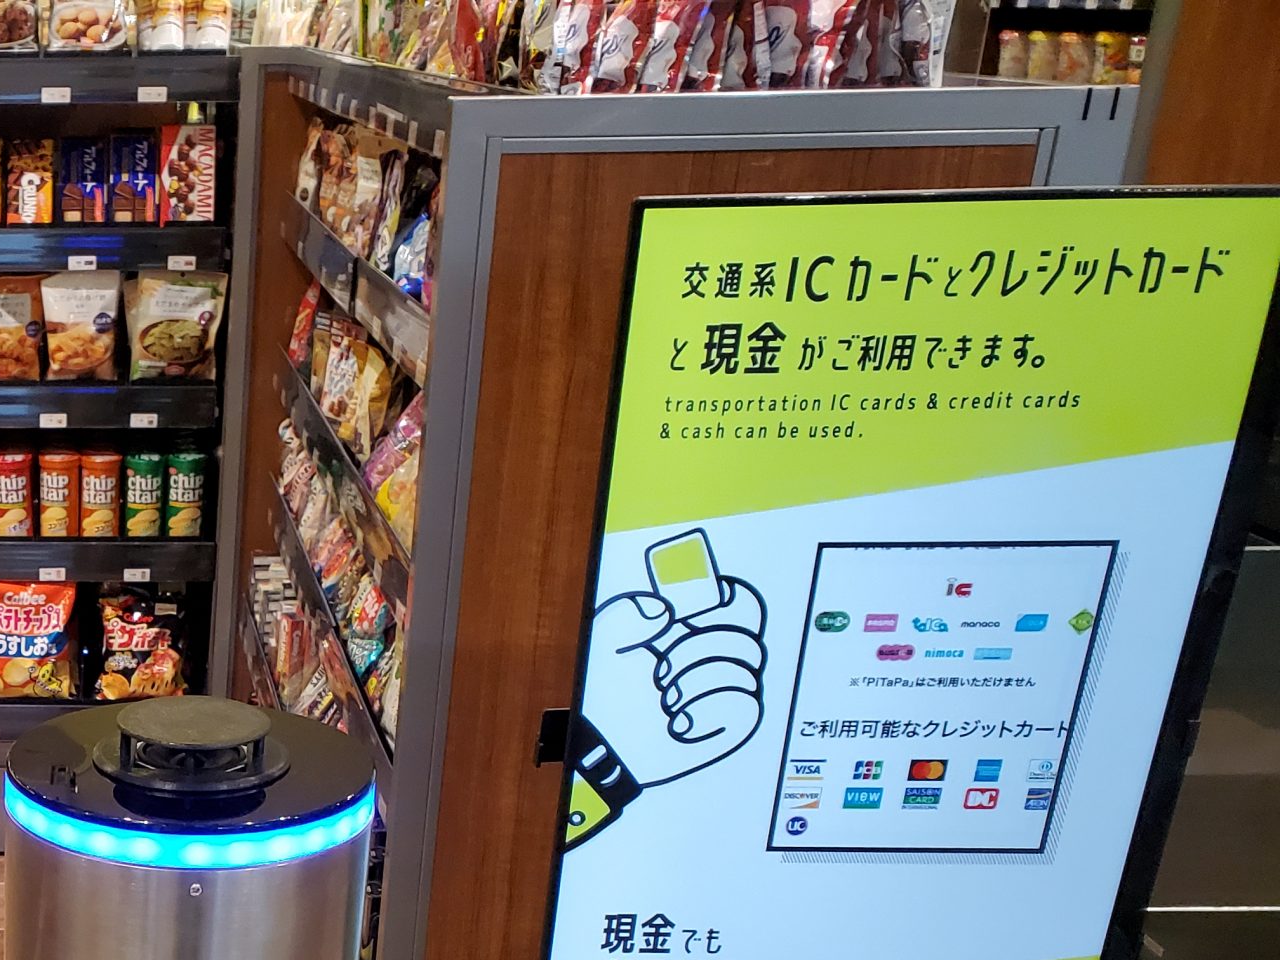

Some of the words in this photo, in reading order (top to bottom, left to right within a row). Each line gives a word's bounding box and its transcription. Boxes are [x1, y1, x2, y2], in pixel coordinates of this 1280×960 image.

[681, 246, 1231, 302] 交通系ICカードとクレジットカード
[665, 394, 821, 416] transportation
[830, 394, 851, 411] IC
[860, 392, 917, 411] cards
[926, 392, 938, 410] &
[948, 391, 1013, 409] credit
[1022, 390, 1081, 409] cards
[660, 422, 671, 439] &
[680, 421, 725, 439] cash
[734, 423, 767, 439] can
[777, 421, 799, 439] be
[808, 420, 864, 438] used.
[82, 475, 117, 493] chip
[128, 475, 161, 493] chip
[170, 474, 203, 491] chip
[82, 489, 116, 504] star
[127, 488, 161, 504] star
[170, 488, 203, 503] star
[3, 589, 47, 606] Calbee
[793, 764, 822, 775] VISA
[788, 820, 807, 832] UC
[600, 913, 722, 954] 現金でも
